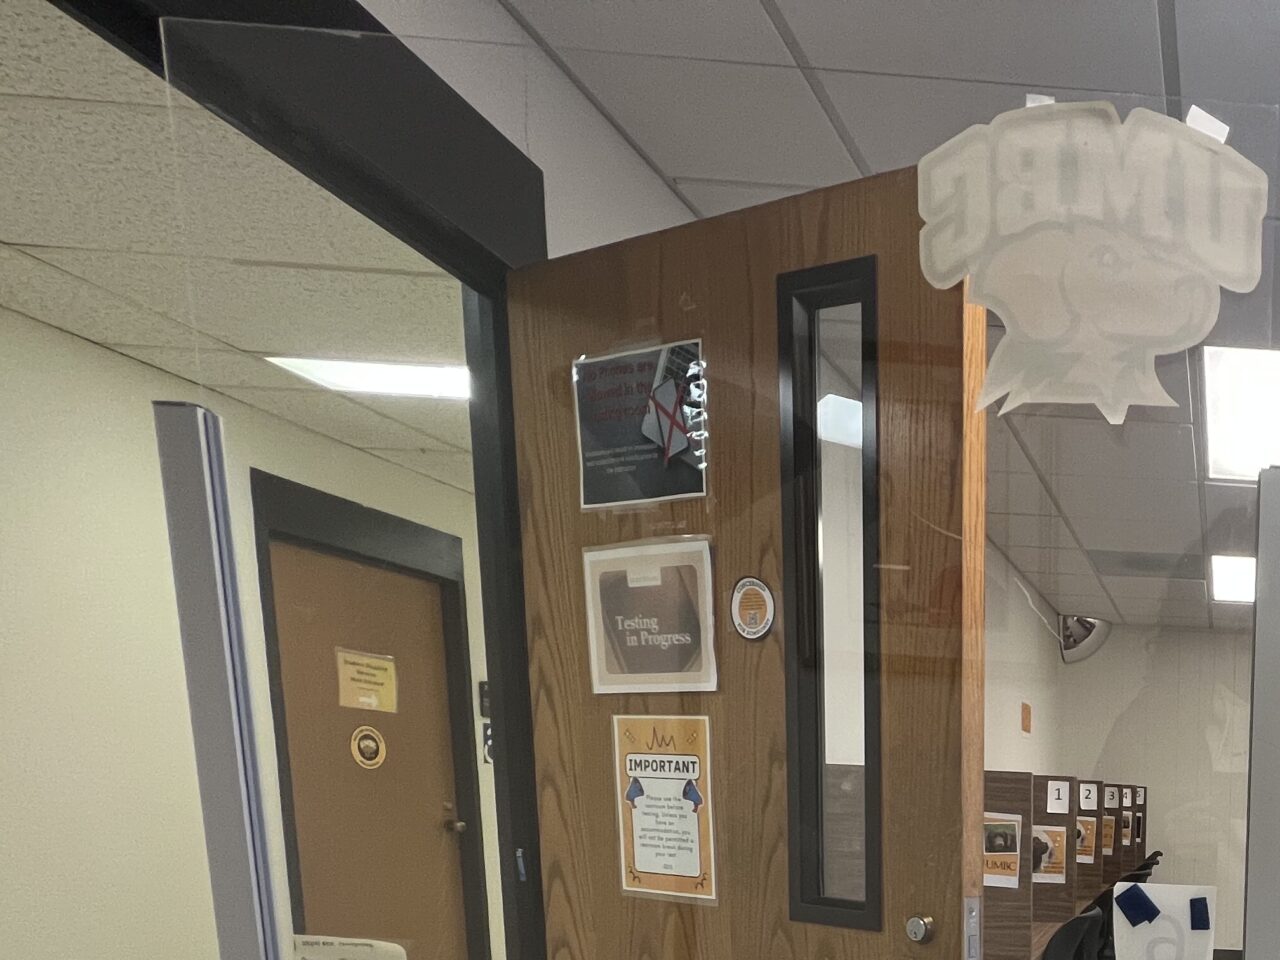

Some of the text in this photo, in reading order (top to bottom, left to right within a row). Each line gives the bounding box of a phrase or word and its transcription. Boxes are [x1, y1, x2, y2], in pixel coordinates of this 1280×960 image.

[615, 614, 659, 632] Testing
[626, 631, 691, 649] in Progress
[629, 758, 697, 773] IMPORTANT
[1055, 788, 1062, 800] 1
[1085, 789, 1092, 799] 2
[1109, 791, 1115, 800] 3
[986, 859, 1017, 871] UMBC
